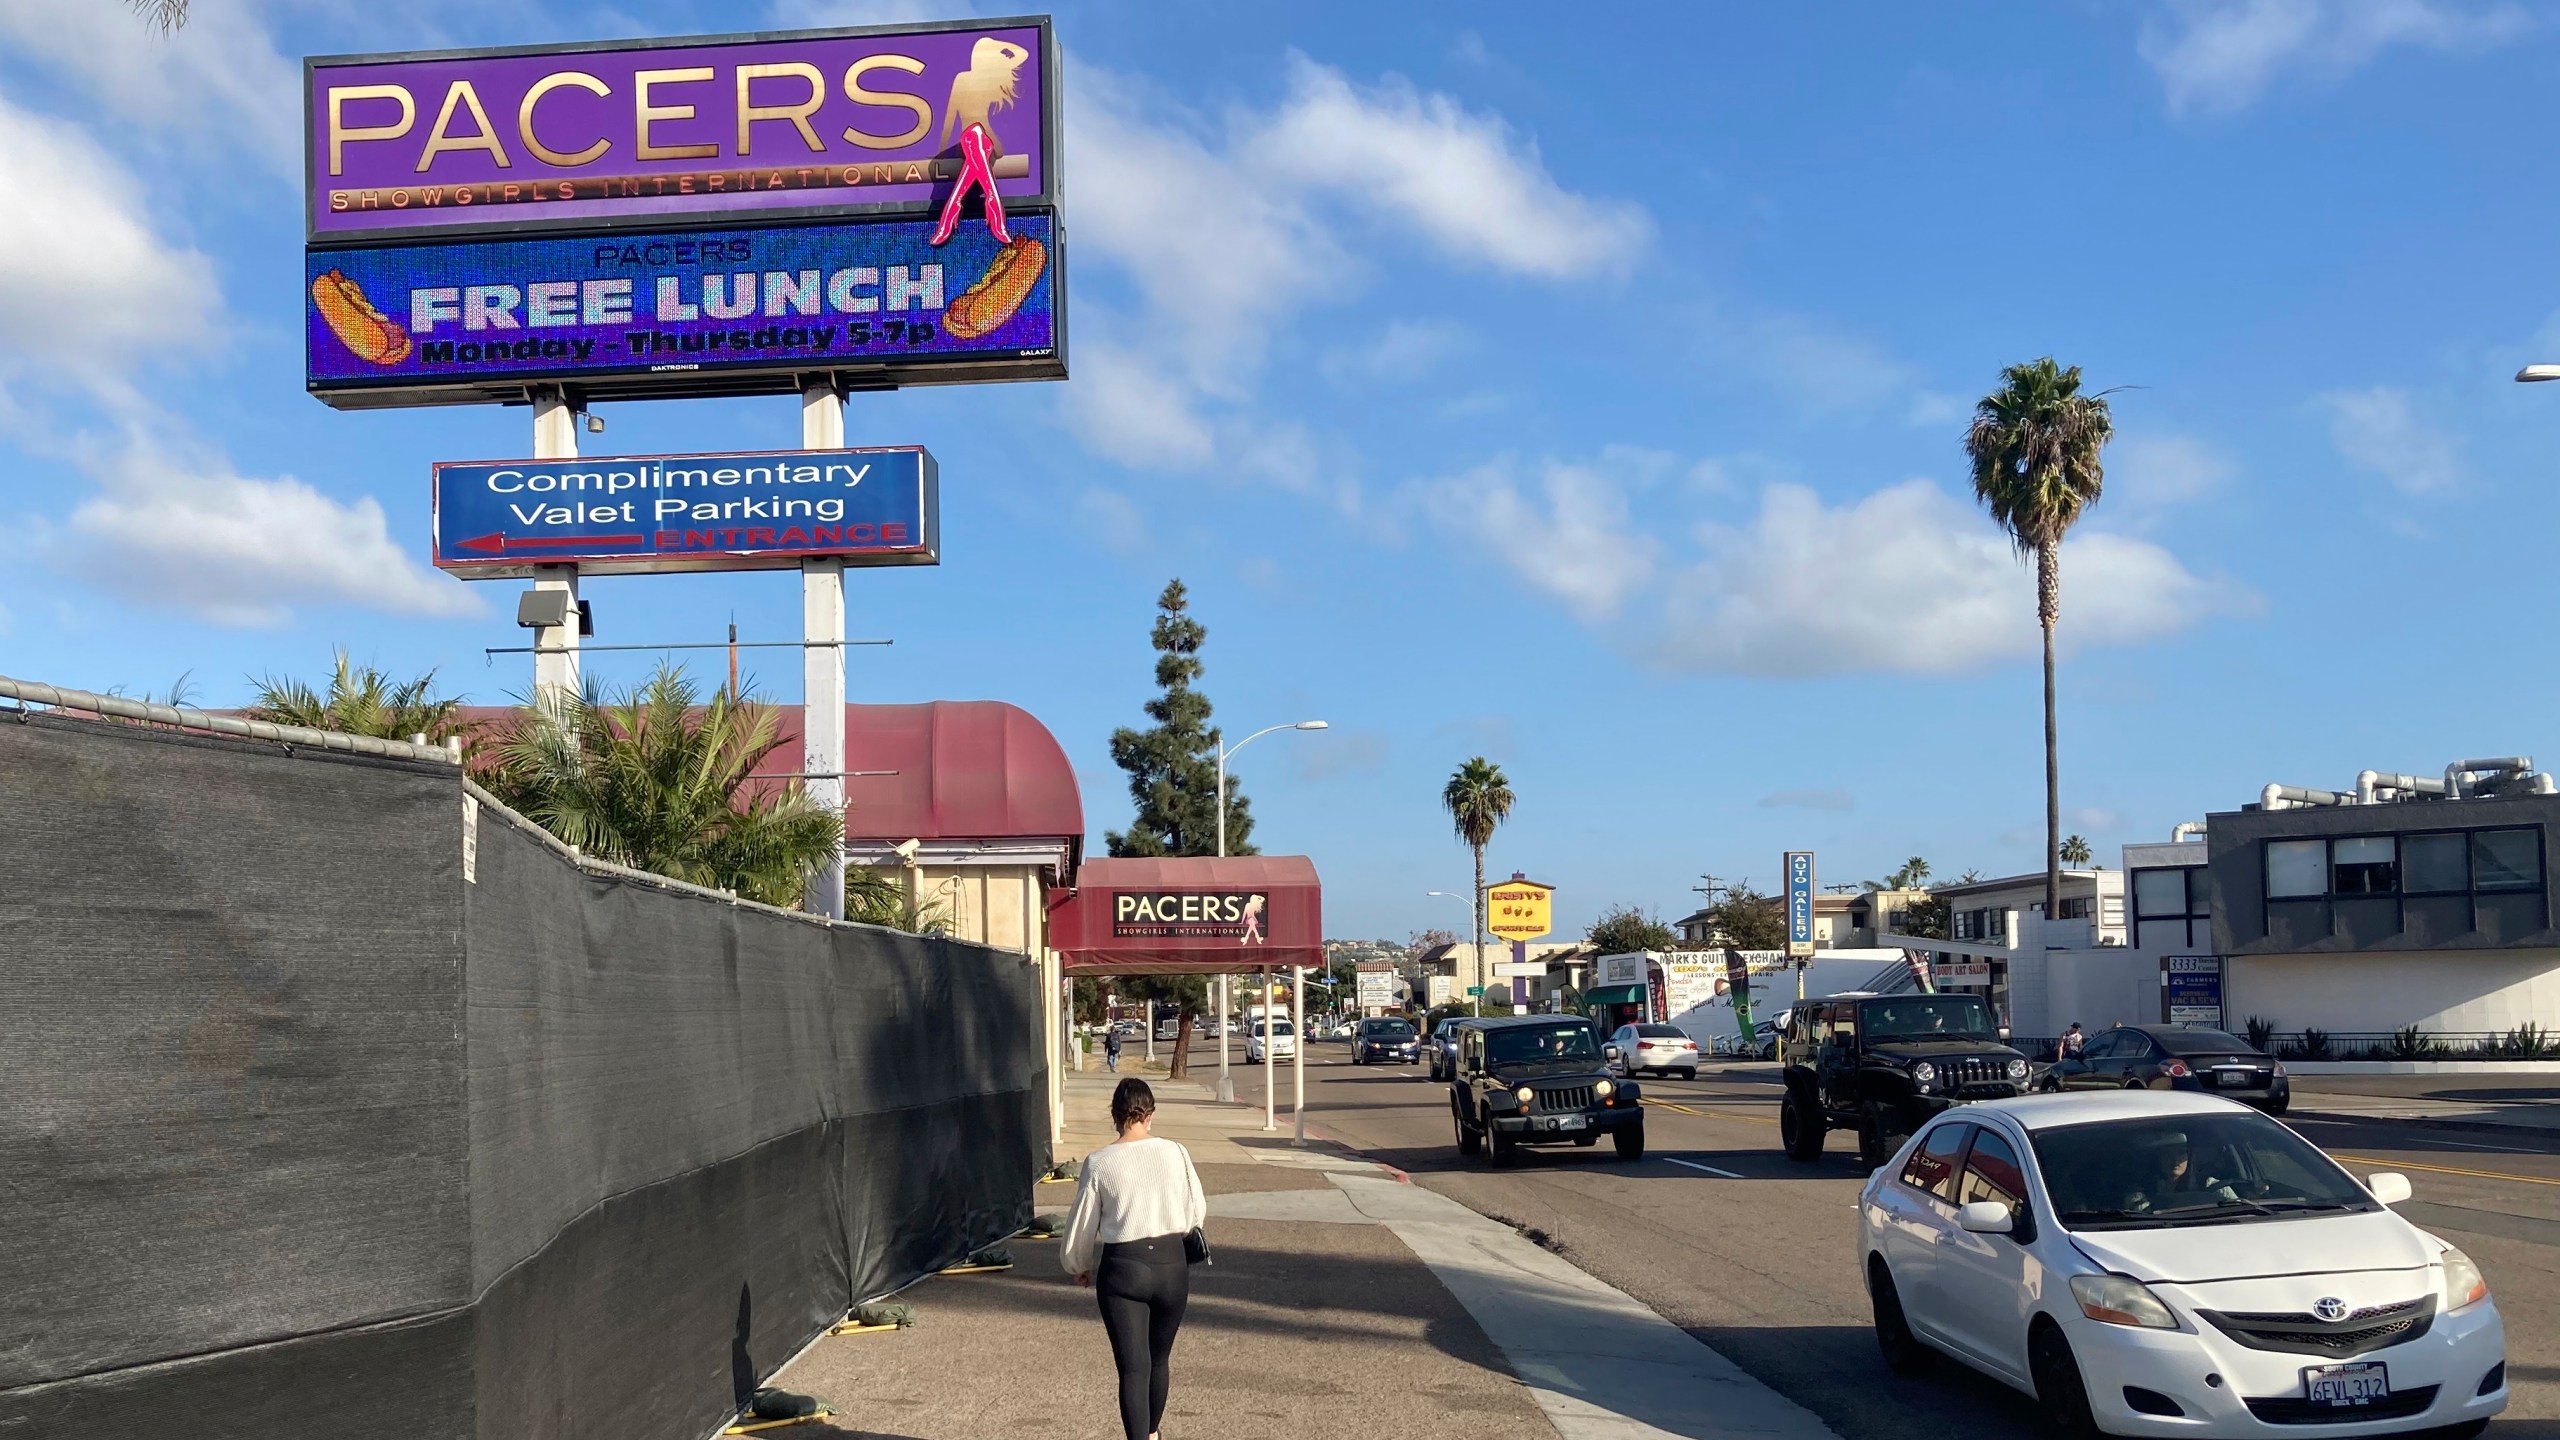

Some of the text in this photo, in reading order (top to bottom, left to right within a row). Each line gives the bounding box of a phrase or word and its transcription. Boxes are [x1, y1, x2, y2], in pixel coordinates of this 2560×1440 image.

[328, 54, 933, 176] PACERS
[332, 163, 949, 210] SHOWGIRLS INTERNATIONAL
[595, 239, 752, 268] PACERS
[410, 263, 943, 334] FREE LUNCH
[421, 337, 596, 363] Monday
[624, 325, 836, 355] Thursday
[848, 316, 936, 346] 5-7p
[487, 463, 871, 495] Complimentary
[510, 496, 845, 525] Valet Parking
[655, 523, 907, 548] ENTRANCE
[1794, 856, 1807, 883] AUTO
[1118, 896, 1241, 922] PACERS
[1794, 891, 1807, 938] GALLERY
[1660, 954, 1698, 964] MARK'S
[1701, 953, 1725, 964] GUIT
[1937, 964, 1988, 975] BODY ART SALON
[2170, 959, 2197, 971] 3333
[2313, 1378, 2382, 1400] 6EVL312
